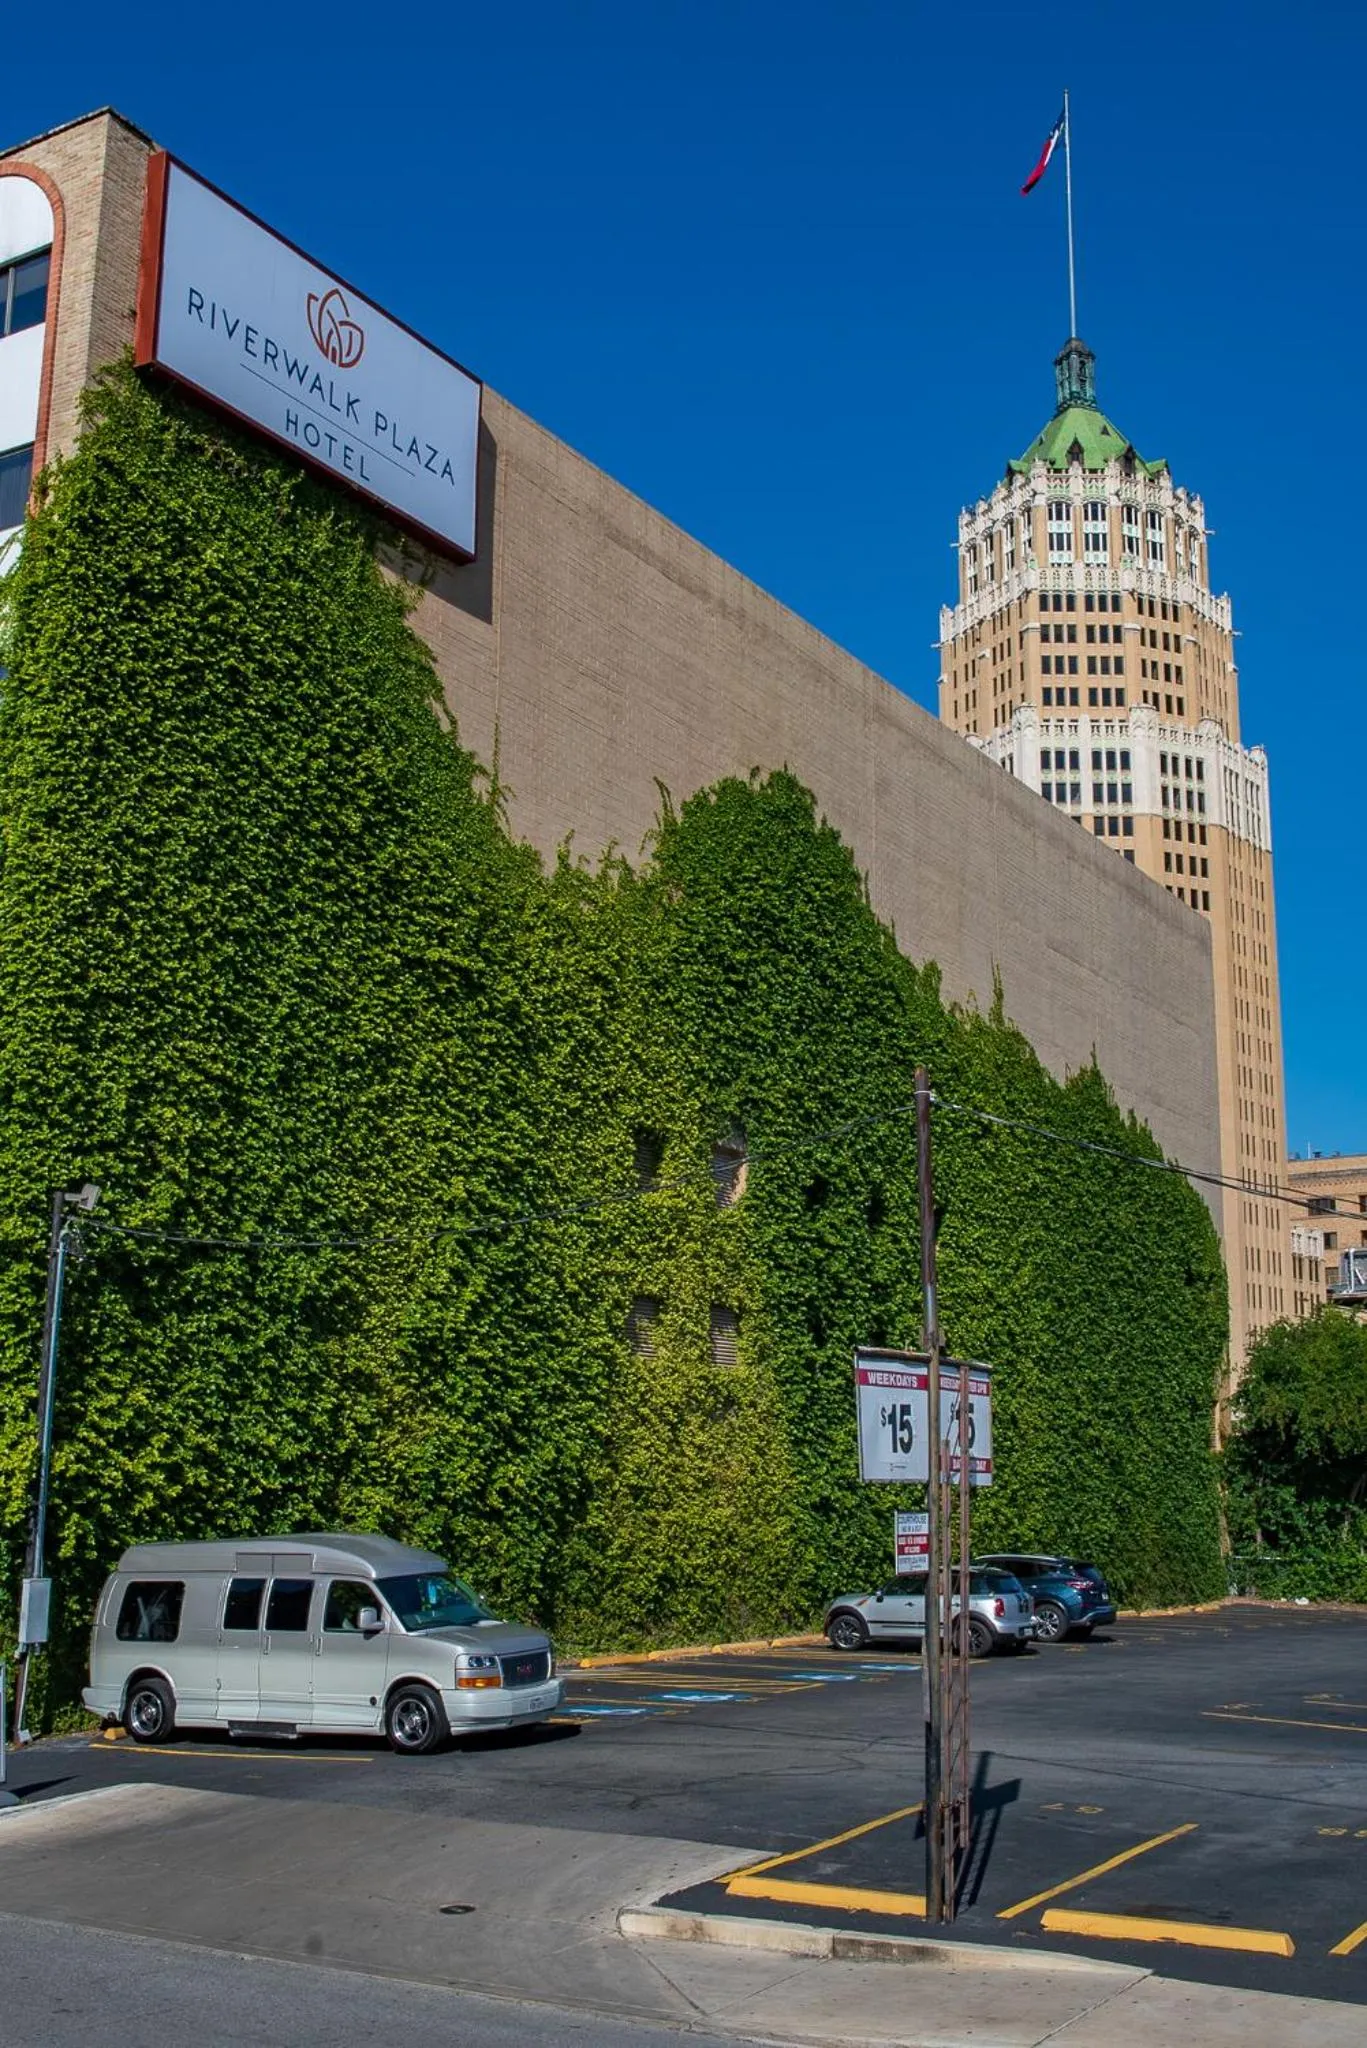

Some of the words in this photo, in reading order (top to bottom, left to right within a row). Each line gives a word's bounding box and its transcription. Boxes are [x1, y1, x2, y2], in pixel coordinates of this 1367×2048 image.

[188, 287, 361, 425] RIVERWALK
[374, 410, 455, 487] PLAZA
[285, 409, 370, 482] HOTEL
[867, 1371, 918, 1388] WEEKDAYS
[880, 1403, 913, 1454] $15
